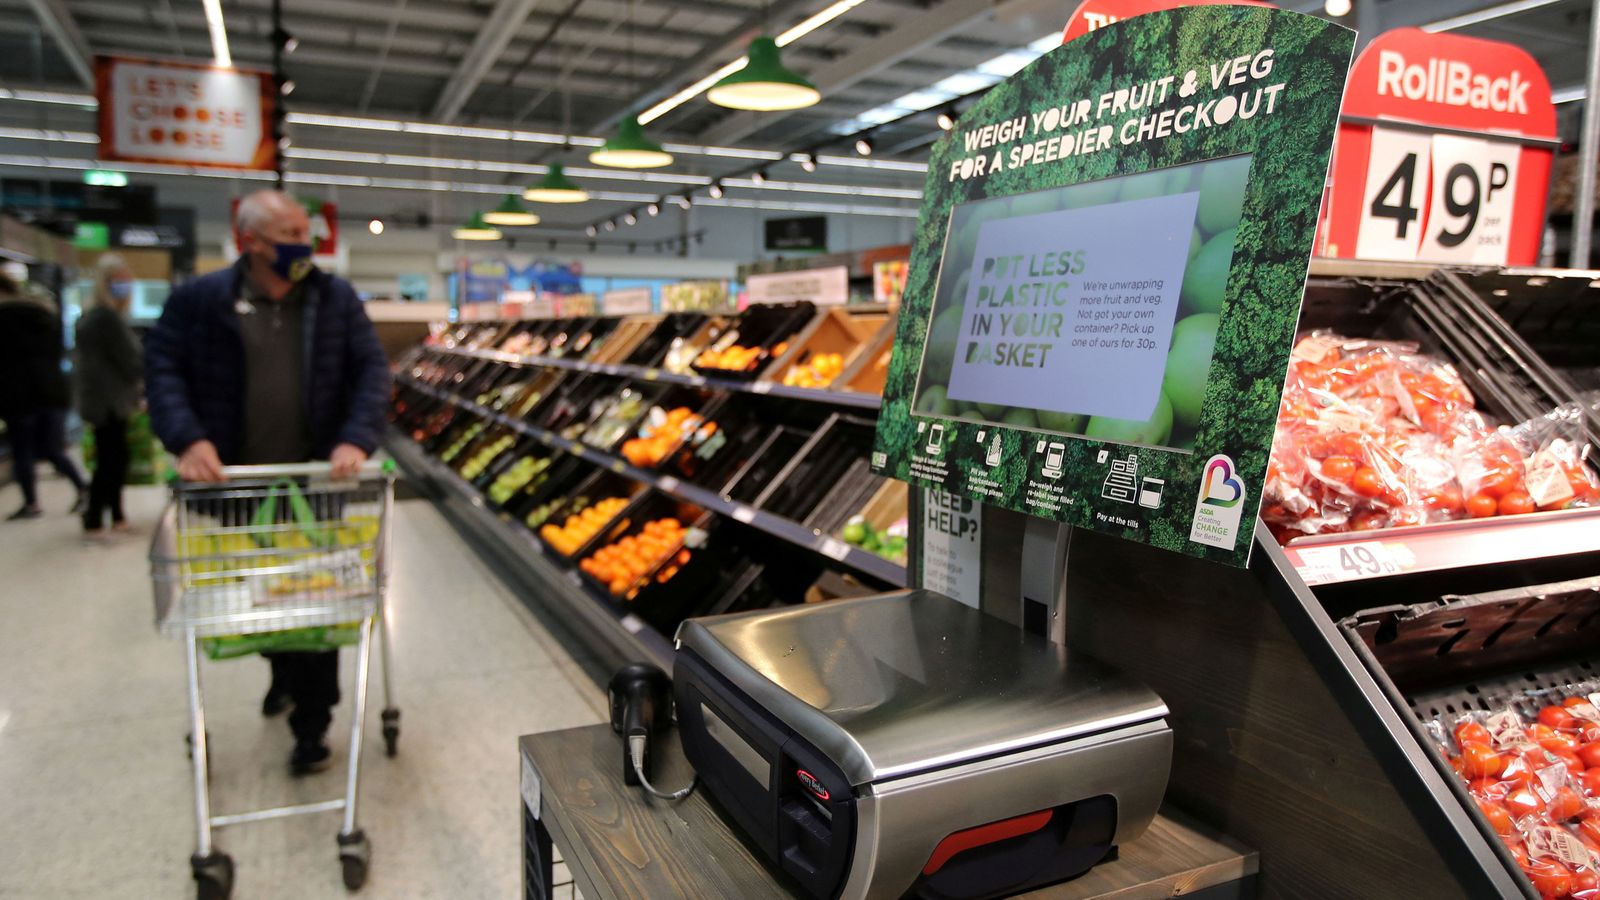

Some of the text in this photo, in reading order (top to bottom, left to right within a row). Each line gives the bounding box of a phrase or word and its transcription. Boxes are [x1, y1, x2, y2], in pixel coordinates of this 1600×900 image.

[1377, 50, 1531, 115] RollBack
[964, 49, 1274, 152] WEIGH YOUR FRUIT & VEG
[130, 102, 247, 128] CHOOSE
[128, 124, 225, 149] LOOSE
[949, 83, 1286, 182] FOR A SPEEDIER CHECKOUT
[982, 250, 1086, 279] PUT LESS
[1083, 279, 1164, 291] We're unwrapping
[976, 281, 1070, 308] PLASTIC
[1080, 293, 1163, 305] more fruit and veg.
[1077, 310, 1155, 320] Not got your own
[970, 312, 1064, 338] IN YOUR
[1074, 323, 1155, 335] container? Pick up
[1071, 339, 1087, 347] one
[1088, 337, 1099, 347] of
[1100, 339, 1119, 348] ours
[1121, 337, 1134, 348] for
[965, 341, 1052, 368] BASKET
[1029, 480, 1064, 494] Re-weigh and
[928, 488, 973, 514] NEED
[1025, 497, 1061, 511] bag/container
[1060, 496, 1074, 505] filled
[1200, 508, 1214, 516] ASDA
[928, 508, 978, 542] HELP?
[1096, 512, 1108, 522] Pay
[1116, 516, 1126, 525] the
[1127, 520, 1139, 528] tills
[1198, 515, 1221, 526] Creating
[1196, 522, 1229, 536] CHANGE
[1203, 533, 1222, 542] Better
